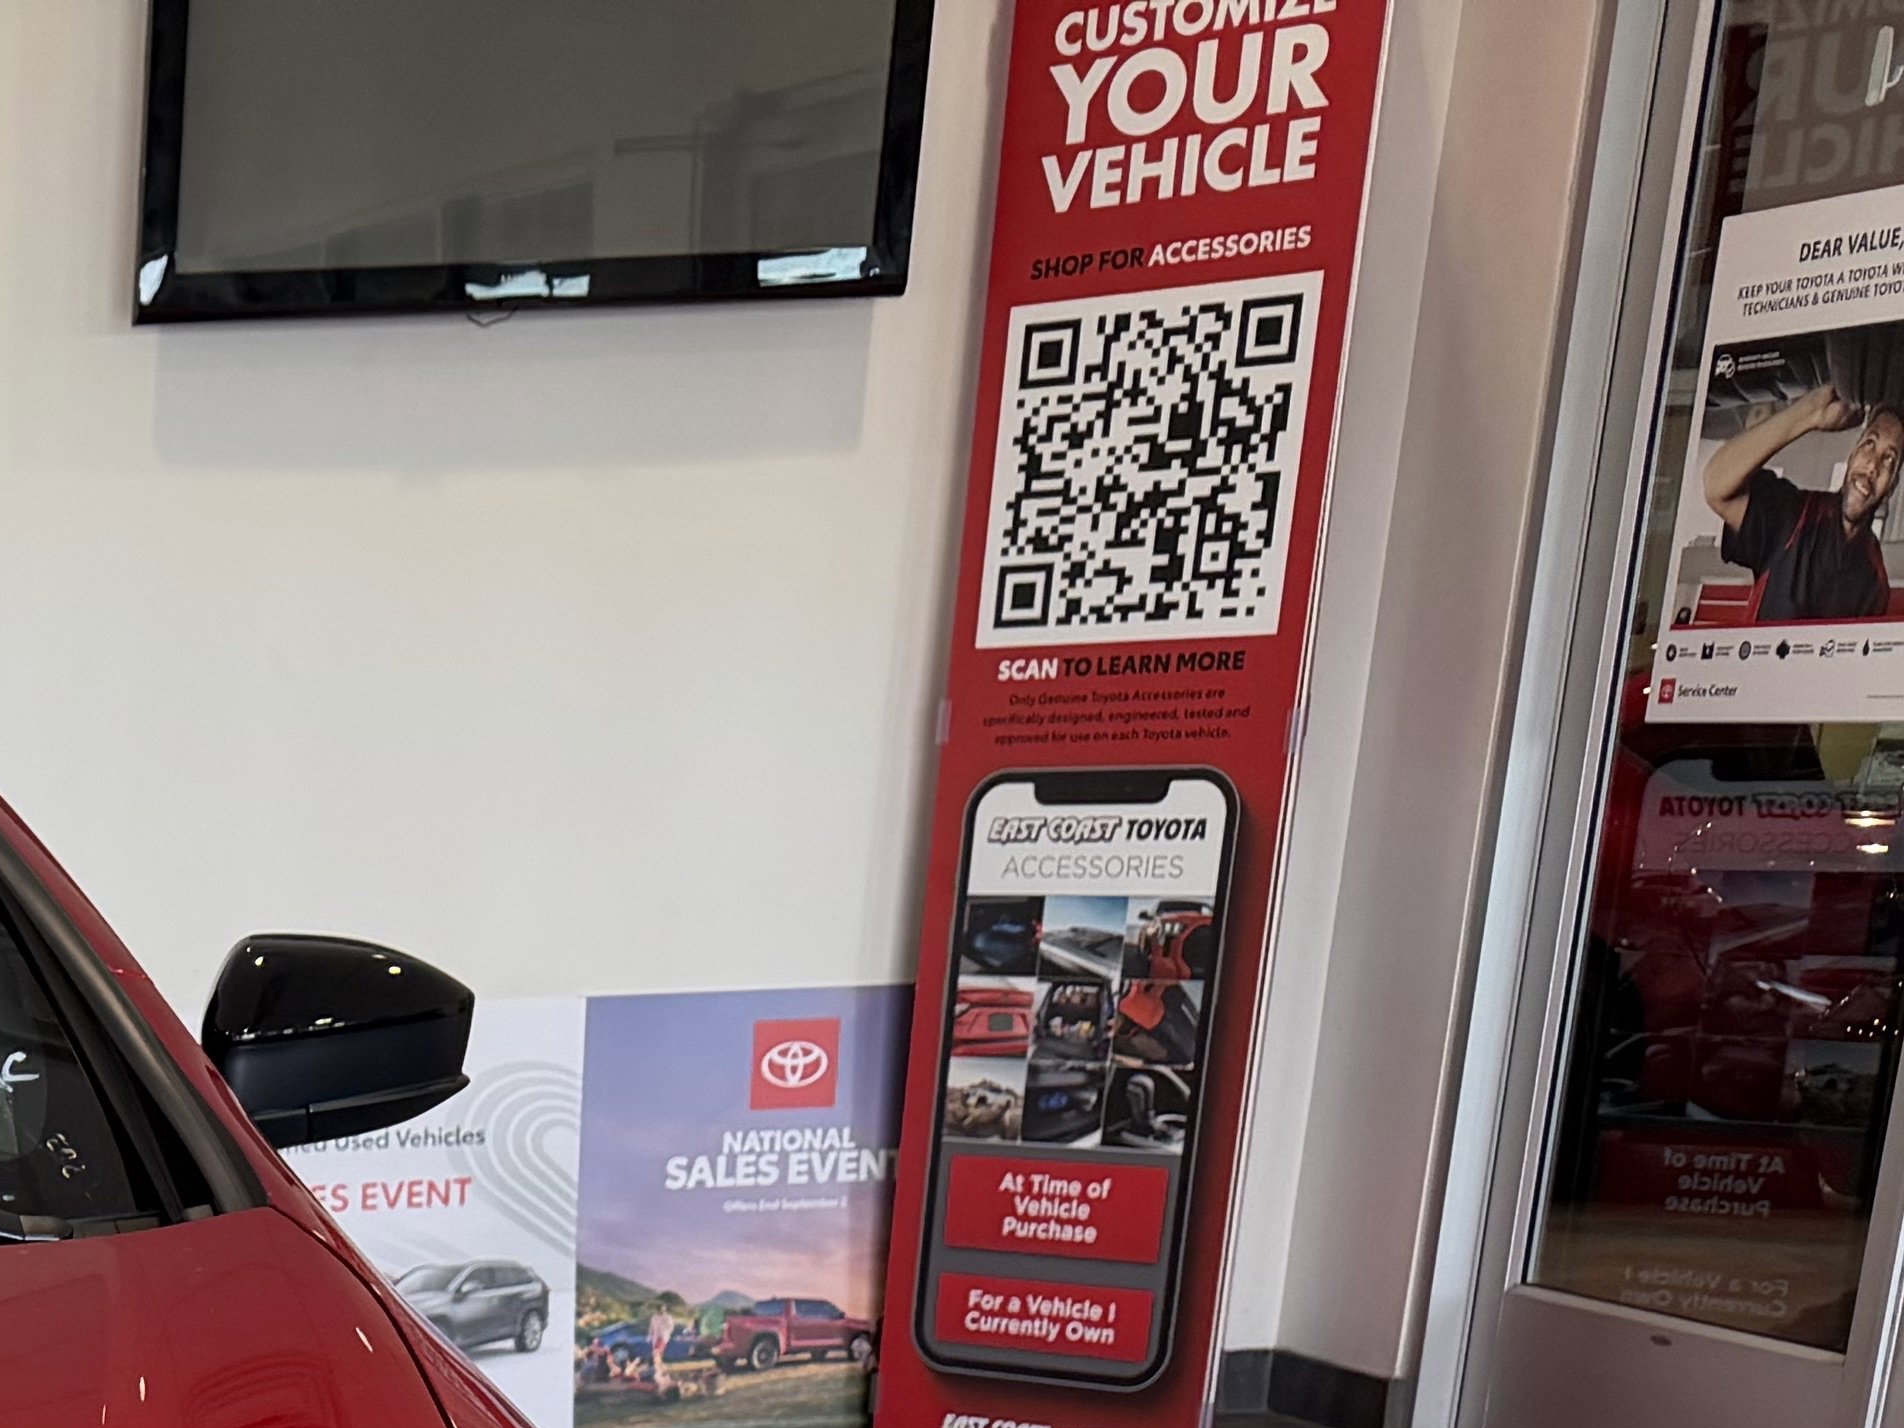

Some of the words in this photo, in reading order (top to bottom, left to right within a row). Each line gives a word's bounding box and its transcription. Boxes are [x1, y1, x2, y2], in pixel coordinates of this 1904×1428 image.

[1049, 23, 1329, 145] YOUR
[1041, 115, 1322, 214] VEHICLE
[1030, 251, 1095, 281] SHOP
[1098, 247, 1145, 273] FOR
[1147, 225, 1312, 267] ACCESSORIES
[1799, 237, 1844, 263] DEAR
[1848, 227, 1904, 257] VALUE,
[1737, 284, 1763, 300] KEEP
[1766, 279, 1792, 296] YOUR
[1796, 273, 1834, 291] TOYOTA
[1837, 271, 1845, 284] A
[1848, 263, 1889, 282] TOYOTA
[1743, 294, 1809, 317] TECHNICIANS
[1812, 291, 1819, 306] &
[1822, 283, 1871, 304] GENUINE
[1874, 279, 1904, 297] TOYO
[997, 657, 1059, 682] SCAN
[1063, 657, 1092, 678] TO
[1096, 653, 1172, 676] LEARN
[1176, 650, 1246, 673] MORE
[1091, 690, 1129, 704] Toyota
[1678, 684, 1706, 698] Service
[1708, 683, 1738, 698] Center
[1225, 705, 1251, 719] and
[1111, 728, 1140, 742] each
[1142, 727, 1182, 742] Toyota
[987, 816, 1047, 845] EAST
[1047, 815, 1123, 845] COAST
[1125, 817, 1207, 841] TOYOTA
[1000, 854, 1185, 880] ACCESSORIES
[396, 1125, 486, 1148] Vehicles
[722, 1126, 856, 1155] NATIONAL
[665, 1152, 780, 1191] SALES
[998, 1171, 1025, 1193] At
[1029, 1173, 1082, 1198] Time
[1086, 1177, 1112, 1200] of
[361, 1177, 473, 1212] EVENT
[1013, 1195, 1091, 1221] Vehicle
[1002, 1216, 1098, 1244] Purchase
[967, 1288, 1004, 1311] For
[1007, 1296, 1021, 1313] a
[1025, 1294, 1103, 1321] Vehicle
[1108, 1302, 1116, 1323] I
[964, 1311, 1060, 1342] Currently
[1065, 1321, 1115, 1344] Own
